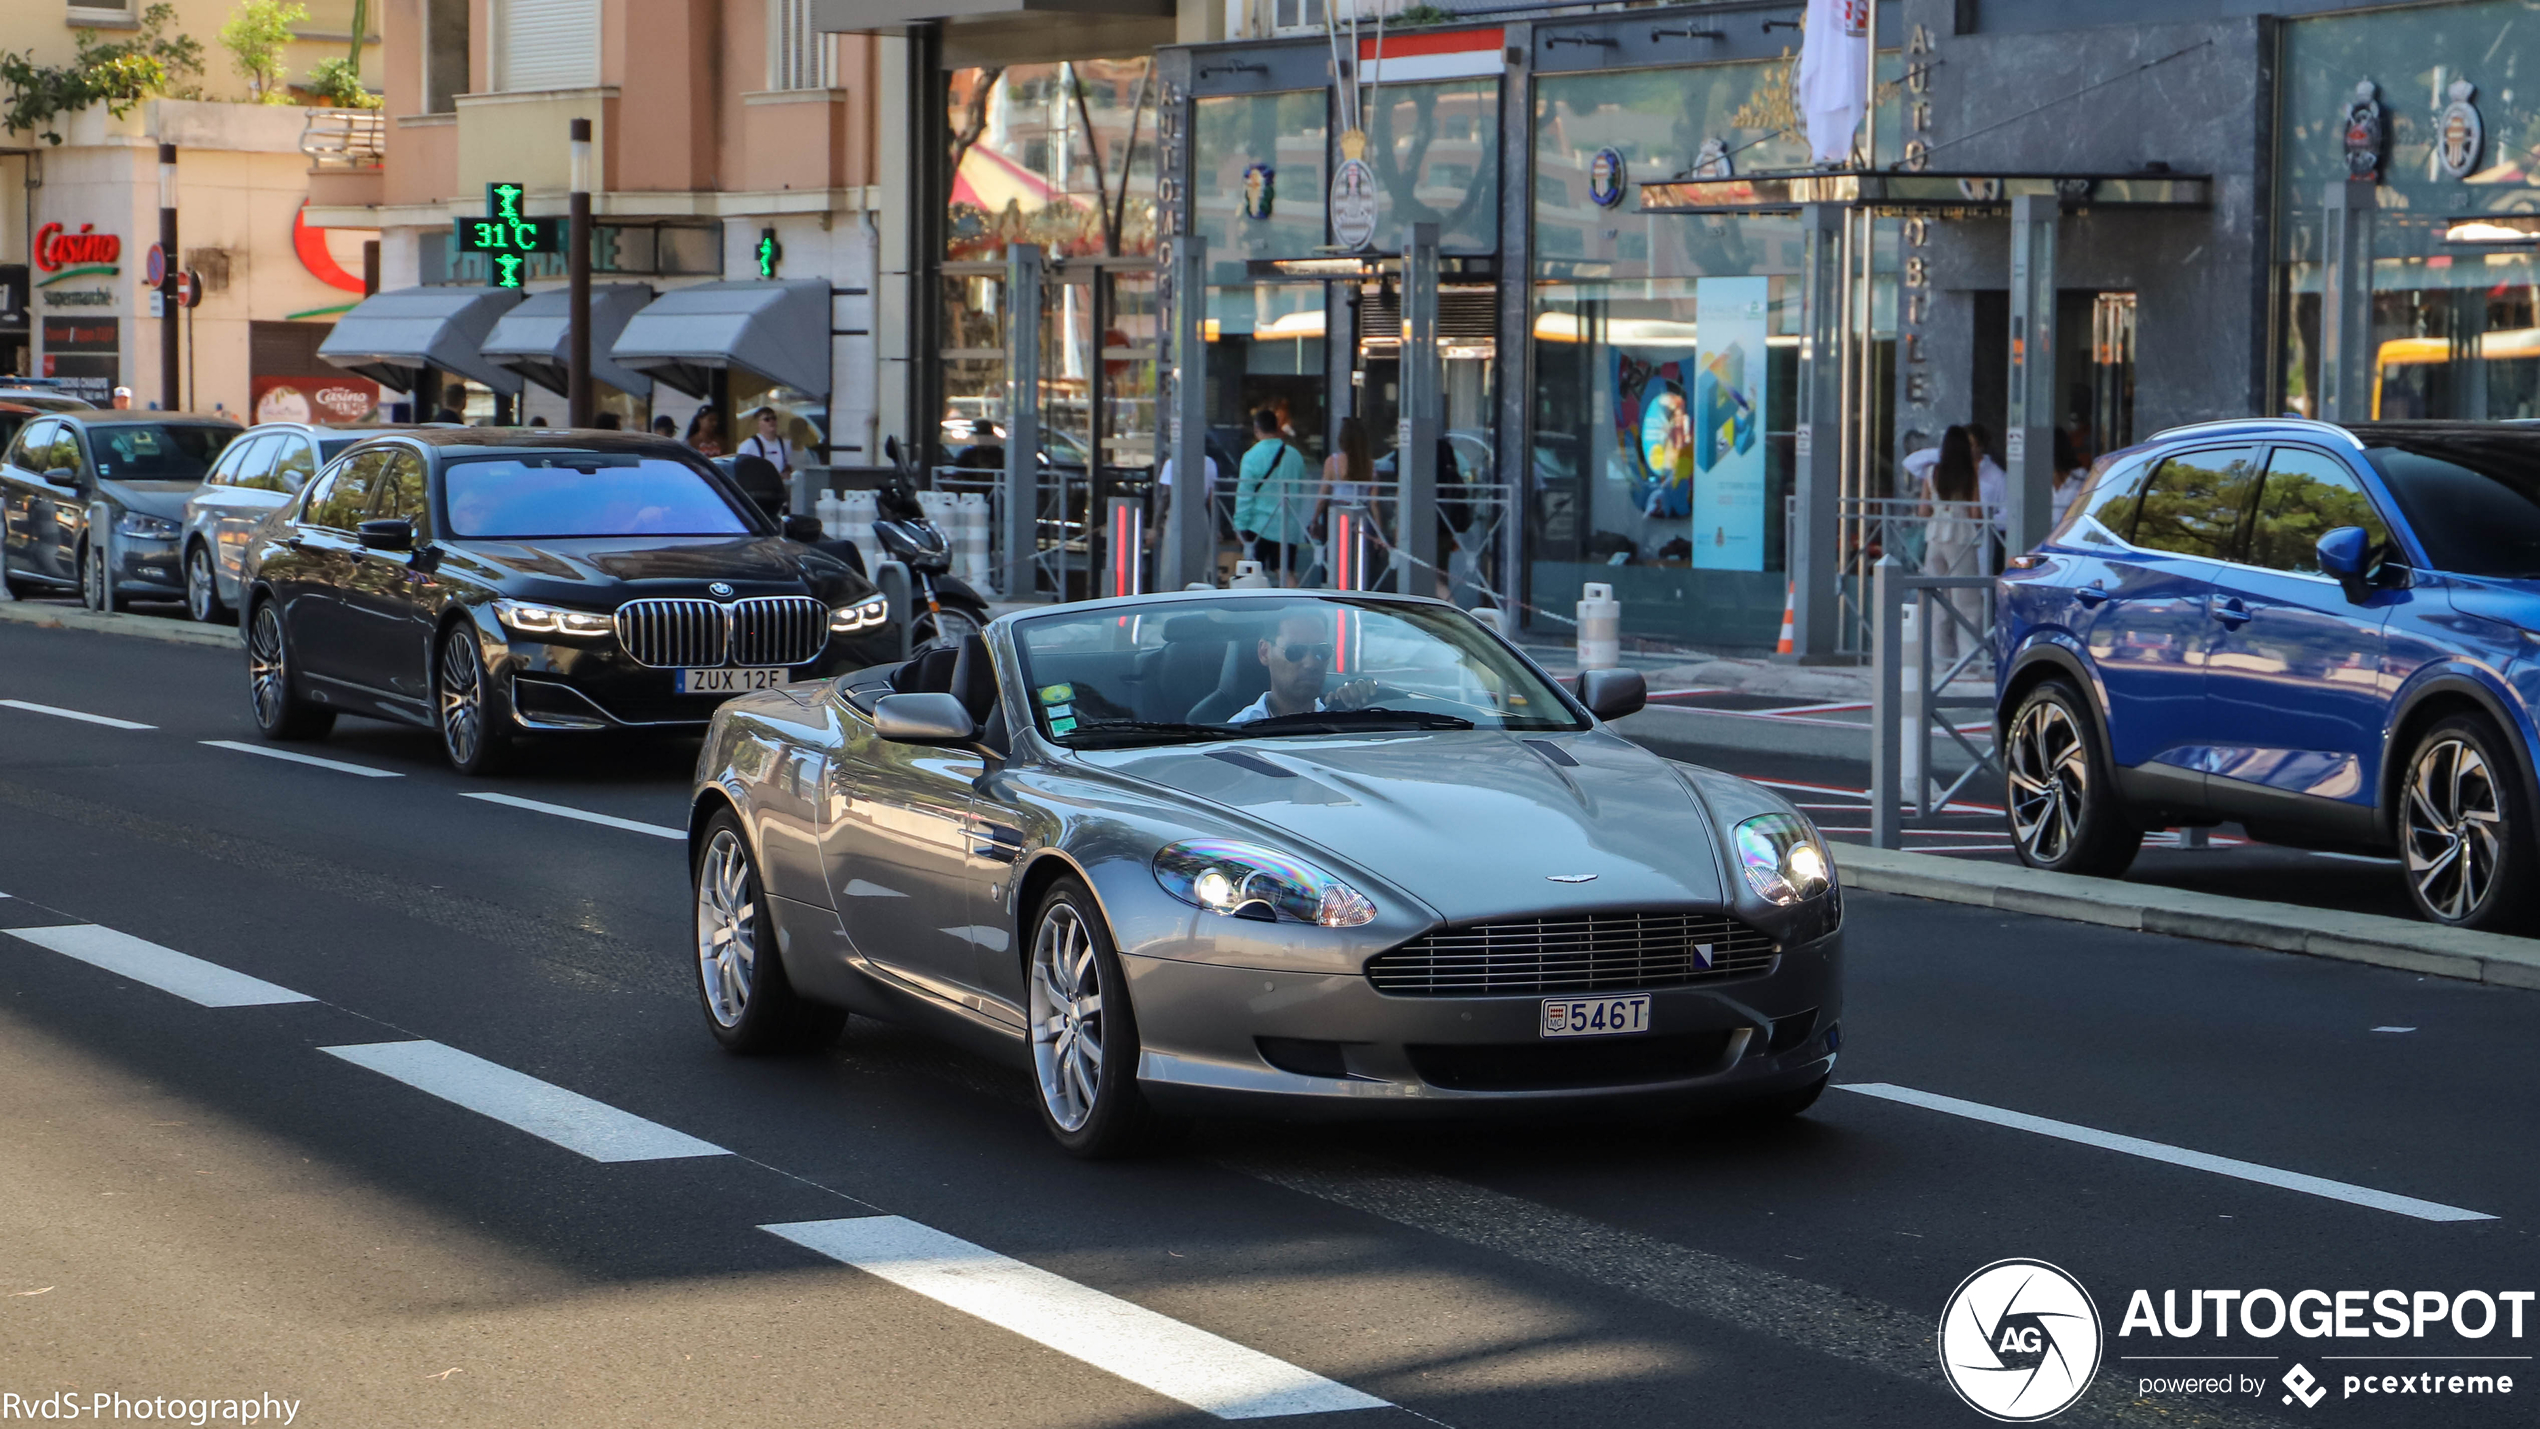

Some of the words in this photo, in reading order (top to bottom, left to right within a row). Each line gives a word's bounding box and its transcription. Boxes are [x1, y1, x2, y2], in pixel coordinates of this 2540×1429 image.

[34, 223, 120, 272] Casino
[474, 217, 537, 250] 31°C
[694, 671, 734, 690] ZUX
[743, 670, 780, 689] 12F
[1571, 1000, 1645, 1032] 546T
